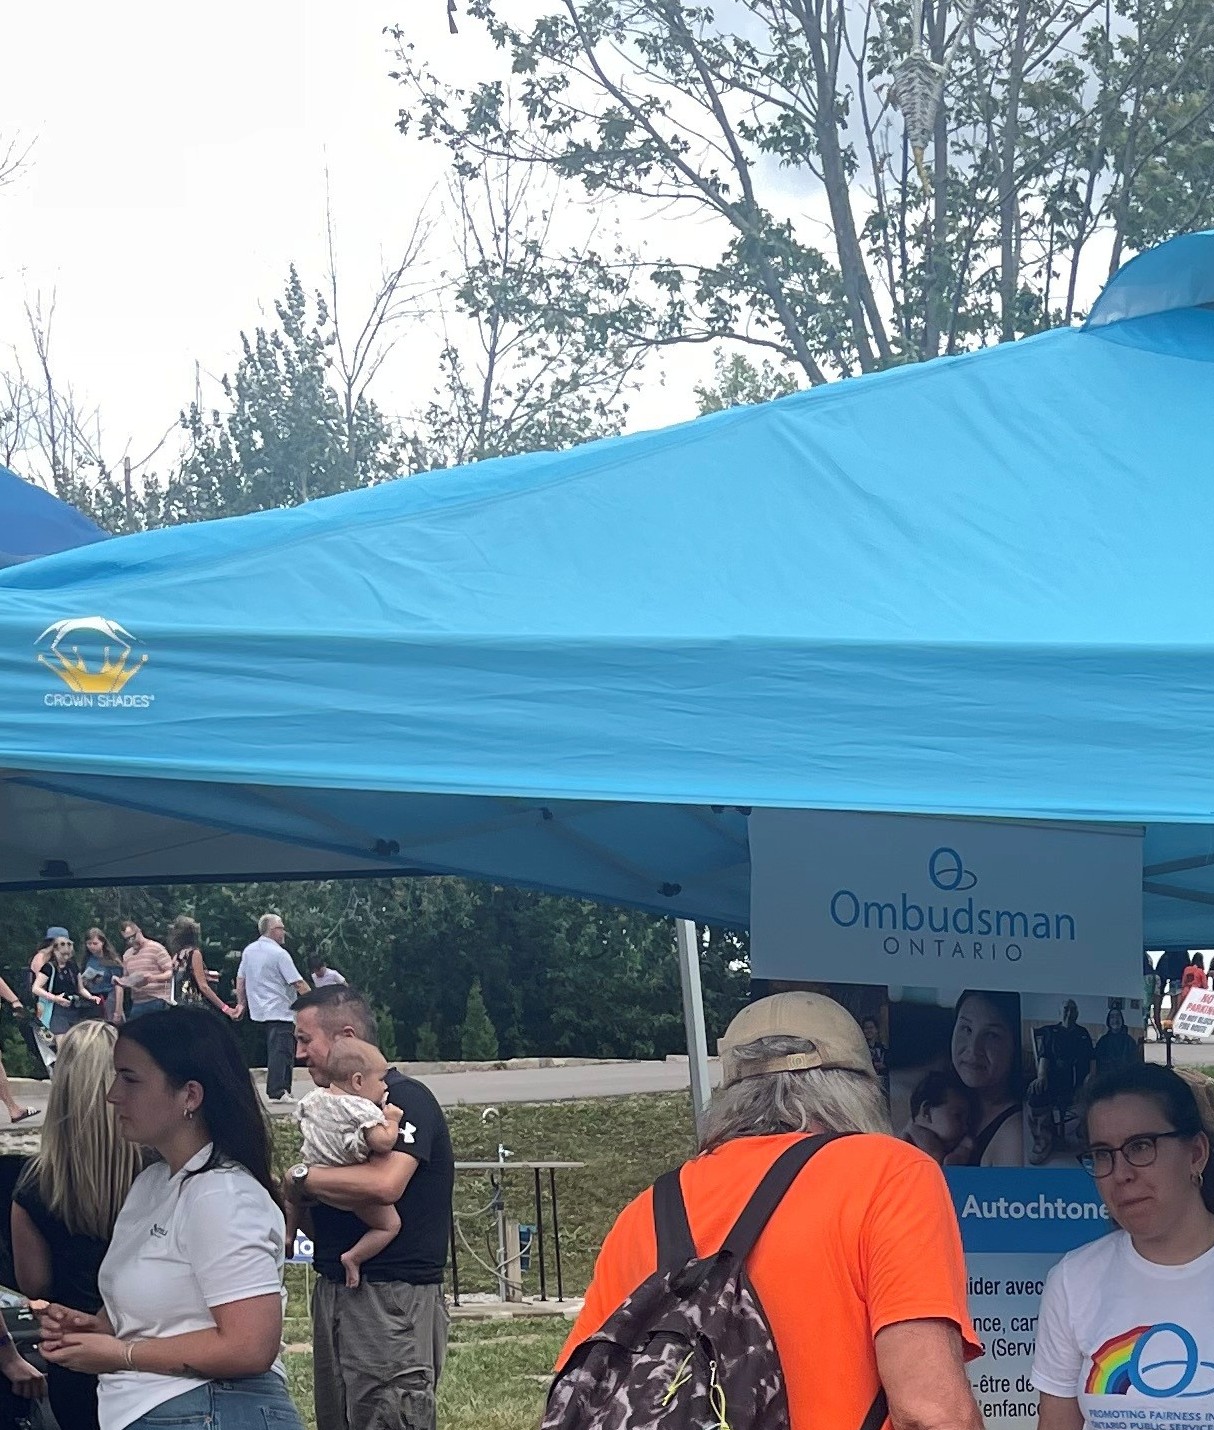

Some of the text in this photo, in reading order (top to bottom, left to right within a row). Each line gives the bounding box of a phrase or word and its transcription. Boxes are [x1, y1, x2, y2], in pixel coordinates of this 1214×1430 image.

[44, 694, 93, 707] CROWN
[829, 889, 1077, 941] Ombudsman
[883, 936, 1023, 962] ONTARIO
[1201, 993, 1214, 1004] NO
[966, 1276, 1044, 1296] ider avec
[1010, 1314, 1039, 1332] car
[1088, 1409, 1146, 1419] PROMOTING
[1149, 1411, 1201, 1421] FAIRNESS
